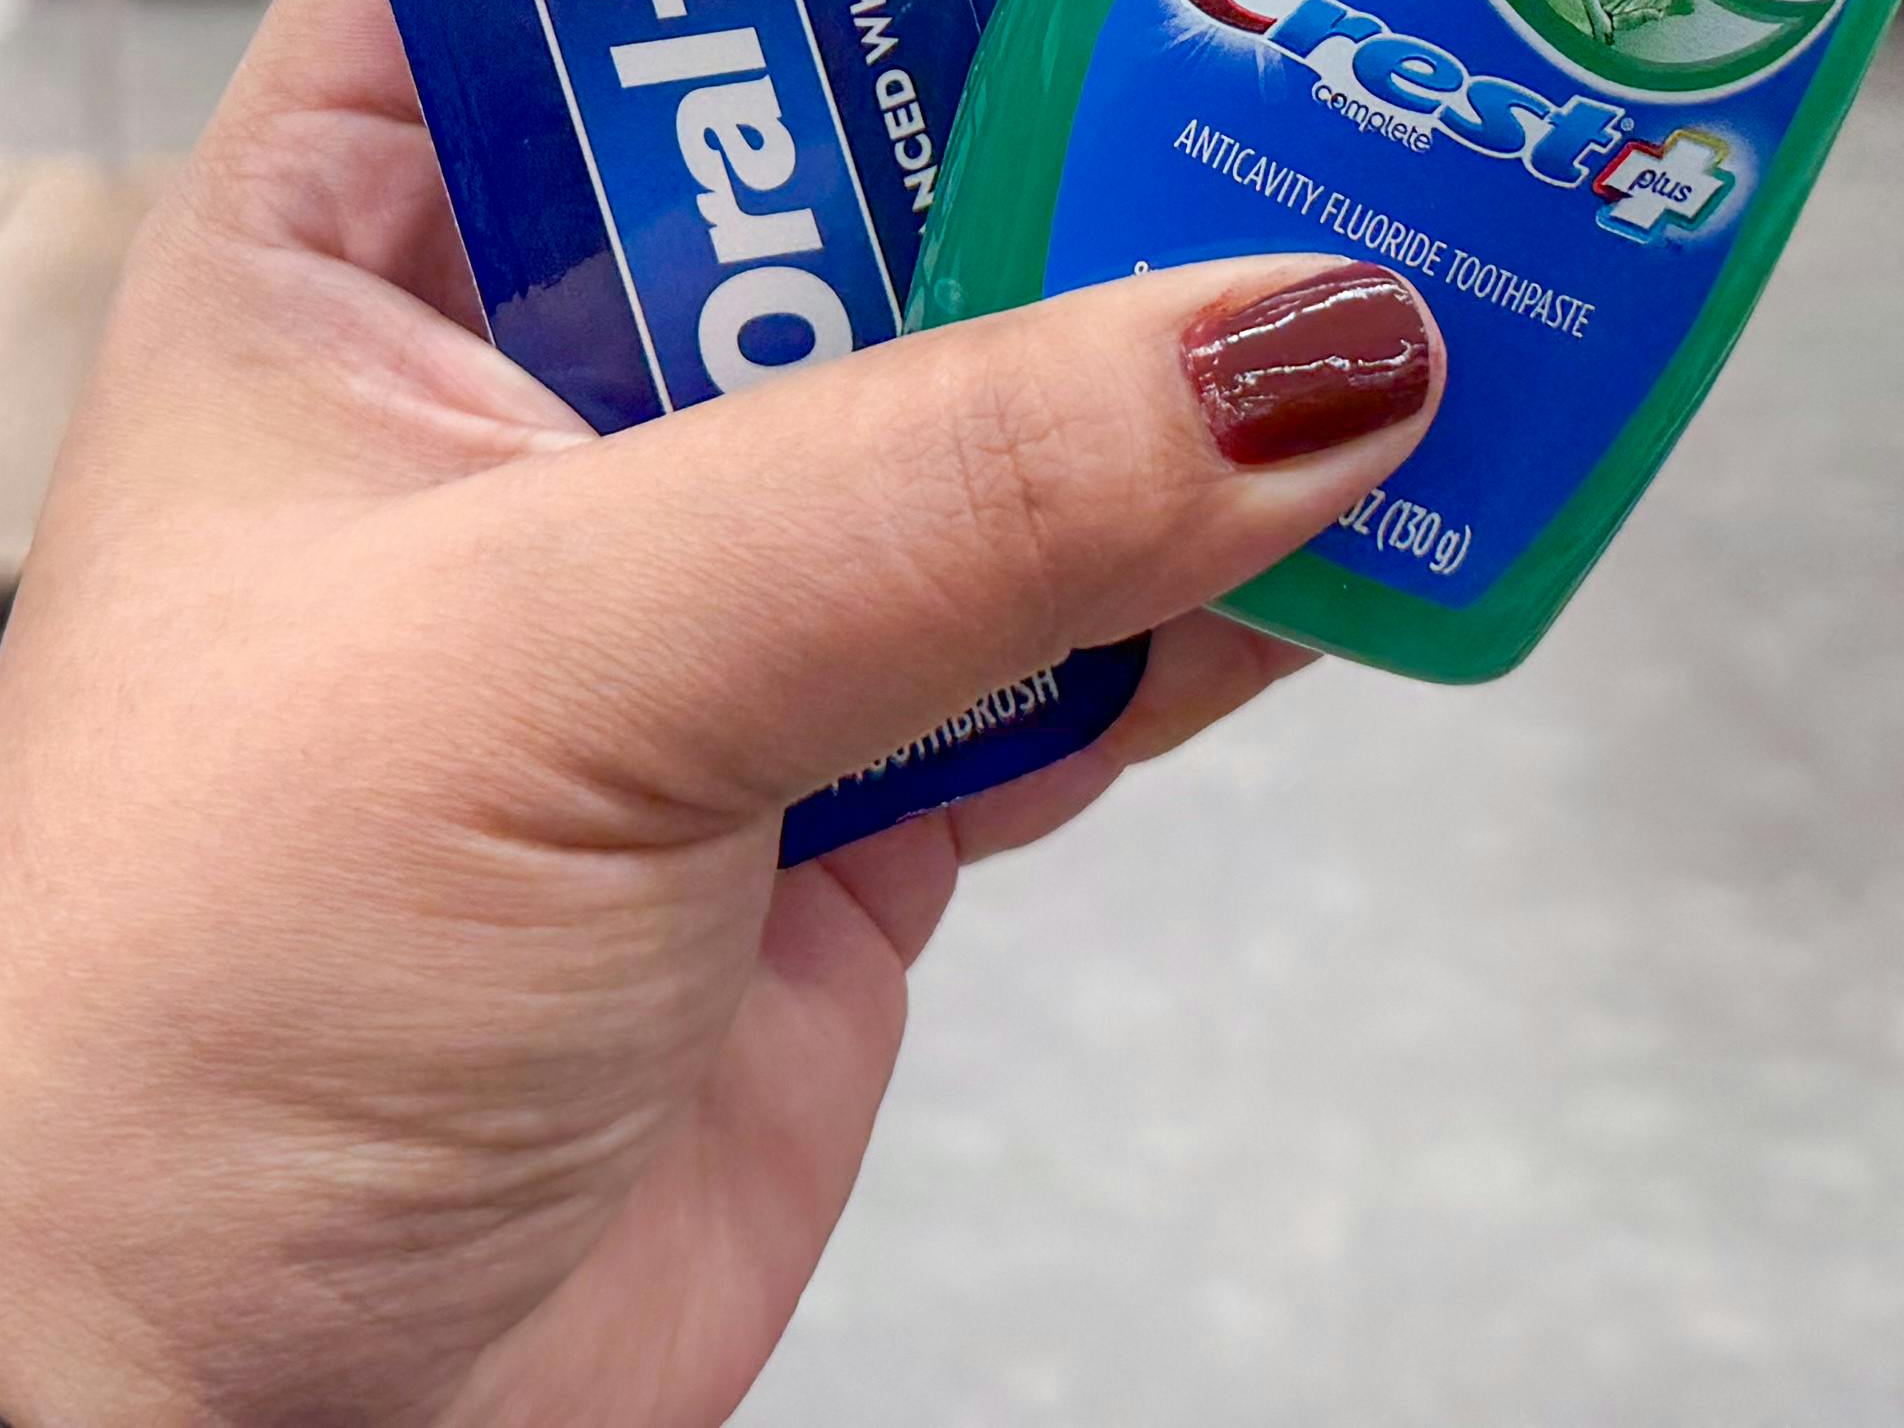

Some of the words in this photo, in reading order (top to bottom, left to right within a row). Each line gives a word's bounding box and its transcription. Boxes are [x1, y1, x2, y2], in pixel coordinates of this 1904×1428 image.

[875, 68, 939, 234] NCED
[1313, 82, 1433, 153] complete
[1628, 168, 1693, 203] plus
[1174, 118, 1325, 216] ANTICAVITY
[1319, 192, 1442, 276] FLUORIDE
[1446, 249, 1596, 340] TOOTHPASTE
[1377, 499, 1442, 558] (130
[1429, 524, 1472, 574] g)
